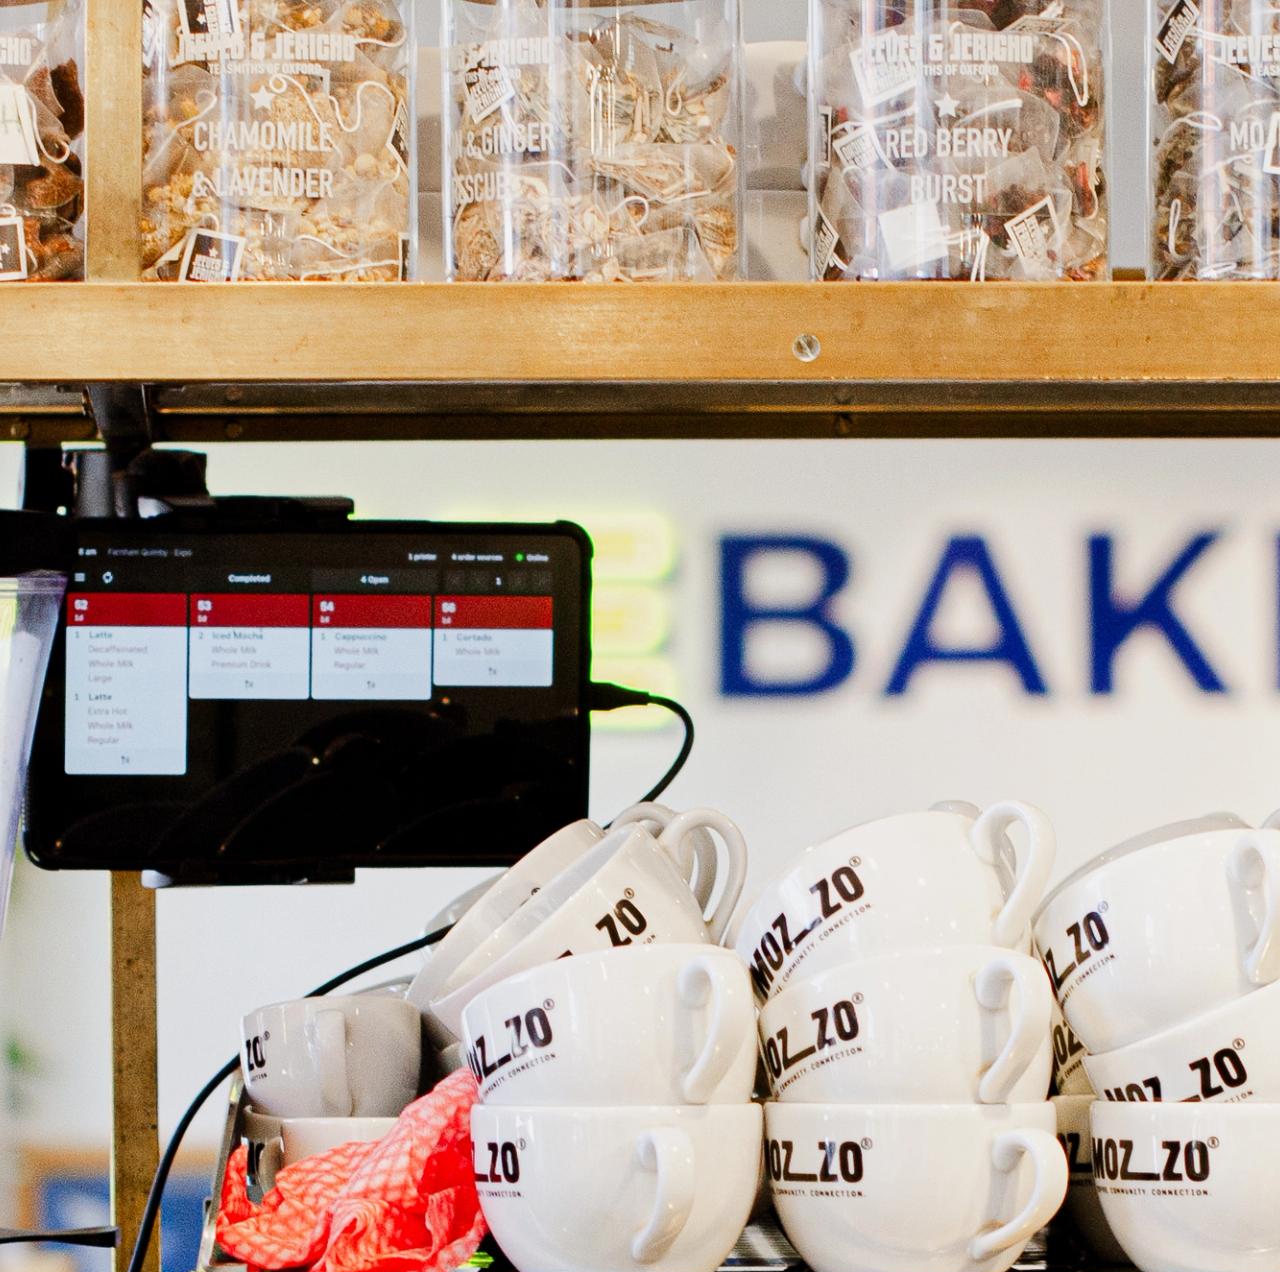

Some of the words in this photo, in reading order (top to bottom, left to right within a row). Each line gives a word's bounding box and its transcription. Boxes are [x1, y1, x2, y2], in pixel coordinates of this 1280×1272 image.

[951, 33, 1034, 63] JERICHO
[194, 121, 334, 152] CHAMOMILE
[482, 122, 555, 155] GINGER
[886, 128, 927, 158] RED
[936, 128, 1012, 158] BERRY
[192, 171, 207, 197] &
[216, 168, 334, 198] LAVENDER
[910, 174, 987, 205] BURST
[228, 573, 271, 584] Completed
[368, 576, 389, 585] Open
[89, 631, 113, 639] Latte
[212, 631, 231, 640] Iced
[233, 631, 264, 640] Mocha
[335, 633, 387, 642] Cappuccino
[456, 633, 492, 642] Cortado
[88, 646, 148, 655] Decaffeinated
[211, 646, 238, 654] Whole
[240, 646, 256, 654] Milk
[456, 648, 482, 656] Whole
[483, 648, 500, 656] Milk
[88, 660, 116, 668] Whole
[117, 660, 134, 668] Milk
[211, 660, 247, 668] Premium
[250, 660, 271, 668] Drink
[334, 661, 365, 670] Regular
[88, 674, 112, 684] Large
[88, 693, 112, 701] Latte
[88, 707, 109, 715] Extra
[88, 722, 115, 730] Whole
[116, 722, 133, 730] Milk
[88, 736, 119, 745] Regular
